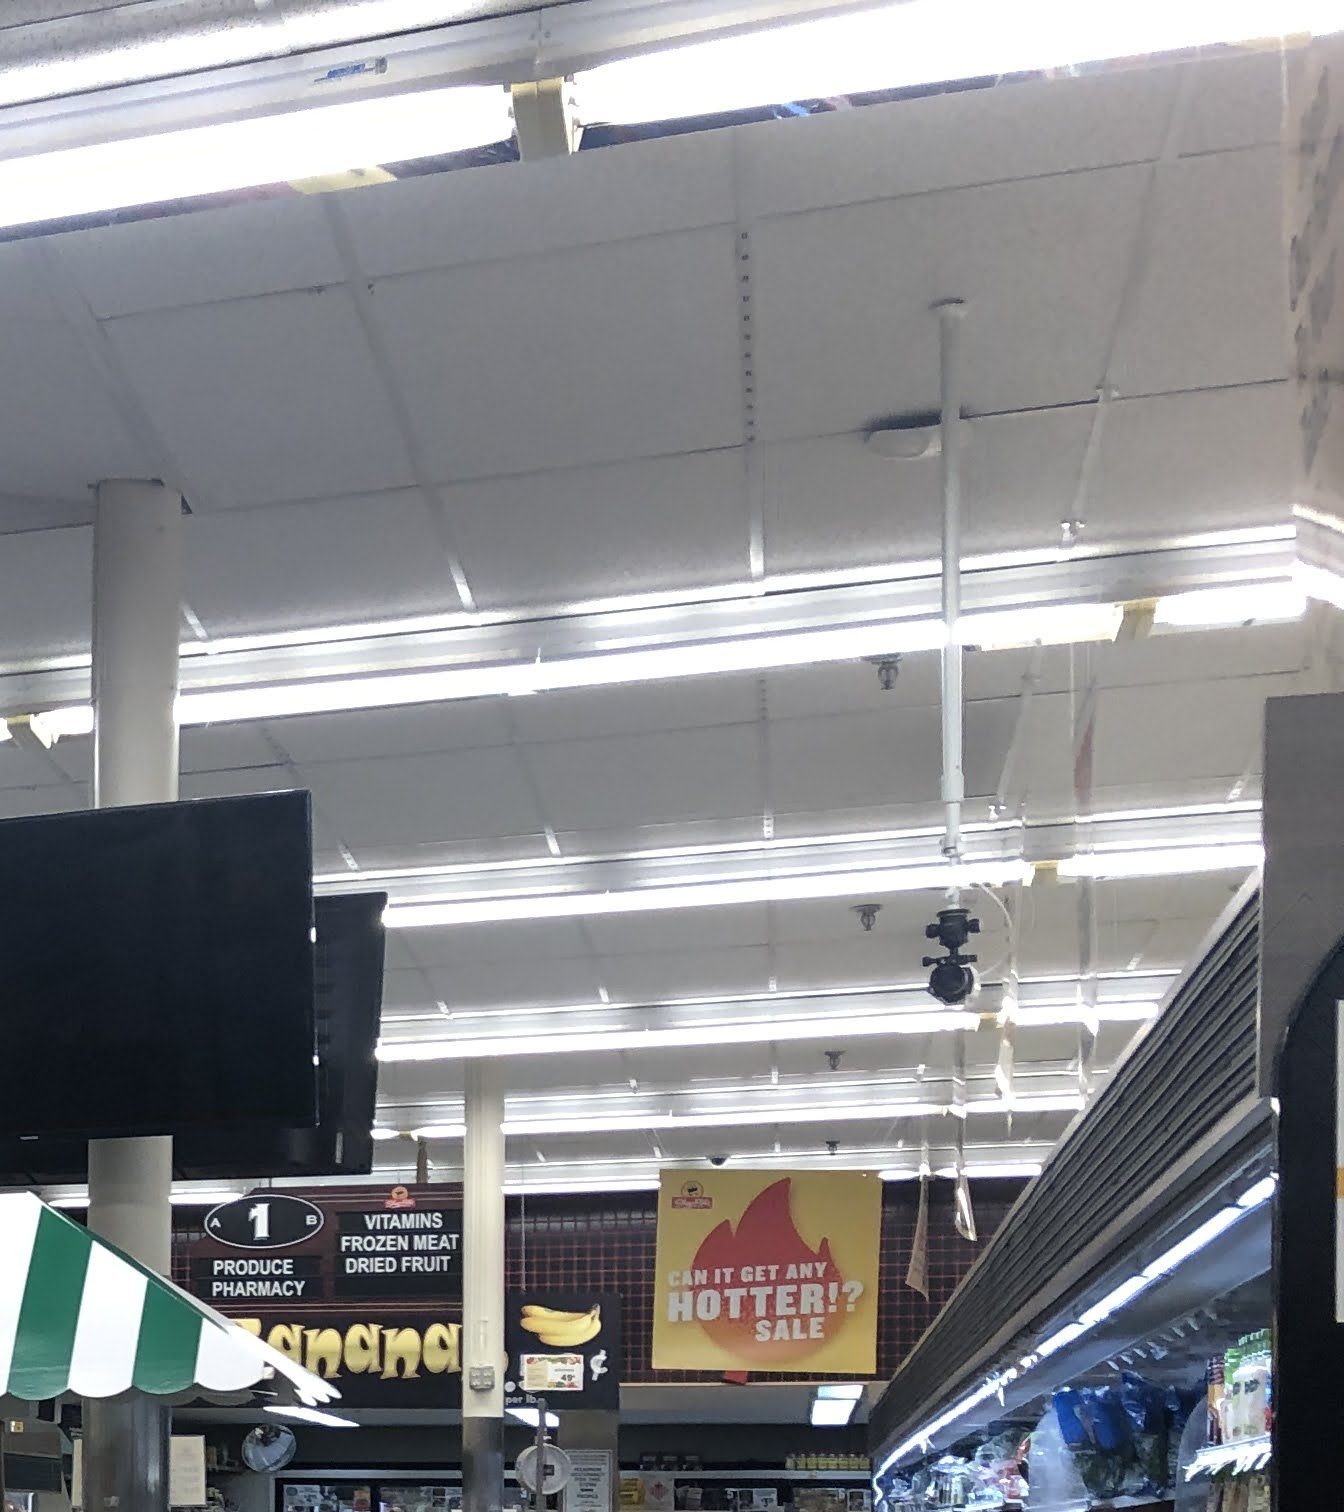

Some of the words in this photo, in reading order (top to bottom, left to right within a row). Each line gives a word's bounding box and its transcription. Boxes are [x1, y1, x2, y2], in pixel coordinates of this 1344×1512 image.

[210, 1216, 222, 1228] A
[247, 1202, 270, 1241] 1
[306, 1214, 318, 1226] B
[364, 1212, 443, 1230] VITAMINS
[341, 1236, 410, 1252] FROZEN
[413, 1234, 460, 1251] MEAT
[213, 1260, 294, 1276] PRODUCE
[345, 1257, 397, 1274] DRIED
[401, 1256, 452, 1273] FRUIT
[668, 1269, 707, 1287] CAN
[715, 1268, 735, 1284] IT
[741, 1265, 780, 1283] GET
[785, 1262, 827, 1280] ANY
[212, 1281, 306, 1298] PHARMACY
[668, 1281, 863, 1322] HOTTER!?
[755, 1317, 825, 1342] SALE
[233, 1318, 462, 1380] anana
